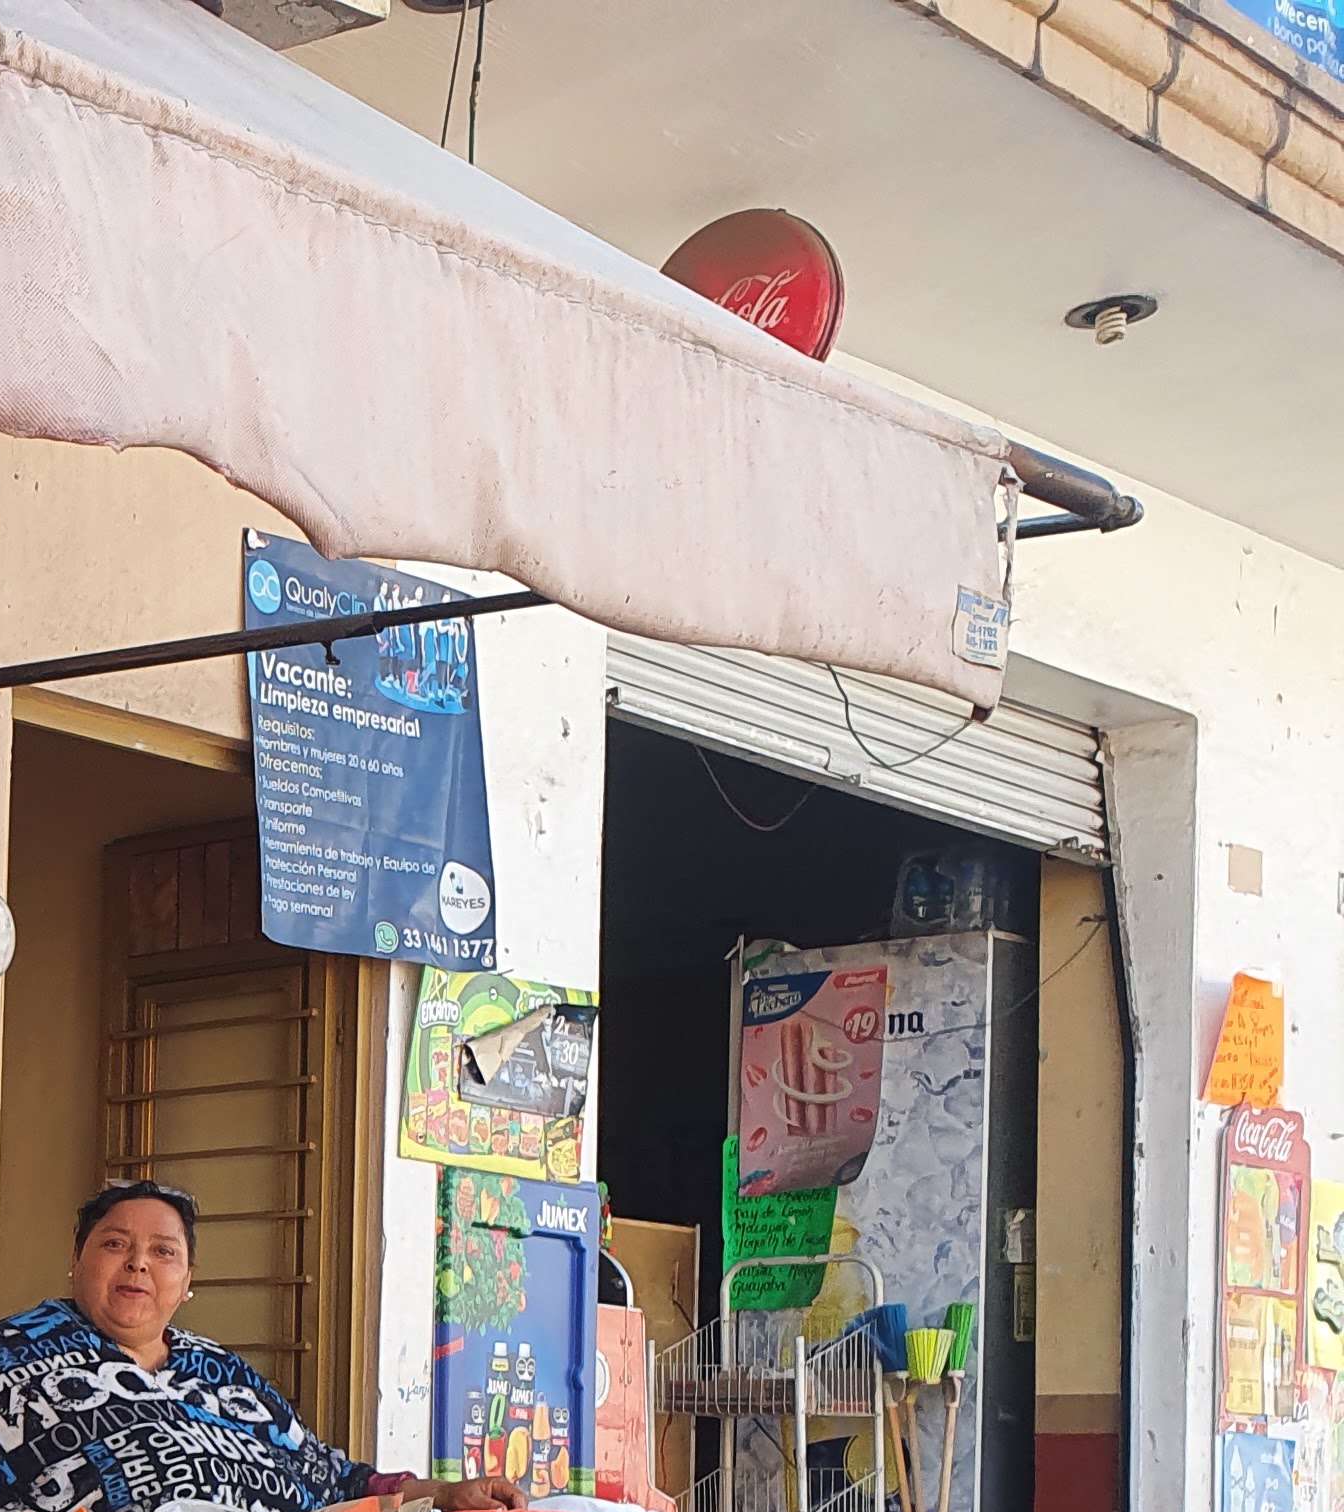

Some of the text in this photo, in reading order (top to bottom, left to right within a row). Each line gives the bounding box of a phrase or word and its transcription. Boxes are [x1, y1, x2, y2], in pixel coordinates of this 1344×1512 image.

[262, 651, 353, 699] Vacante:
[260, 683, 421, 738] Limpieza empresarial
[257, 714, 316, 741] Requisitos:
[310, 748, 346, 767] mujeres
[367, 758, 380, 773] 60
[381, 761, 405, 778] años
[265, 855, 358, 883] Protección Personal
[324, 847, 338, 860] de
[383, 856, 420, 874] Equipo
[421, 861, 436, 876] de
[265, 872, 356, 903] Prestaciones de ley
[290, 901, 334, 919] semanal
[402, 927, 422, 949] 33
[452, 938, 494, 959] 1377
[536, 1200, 589, 1233] JUMEX
